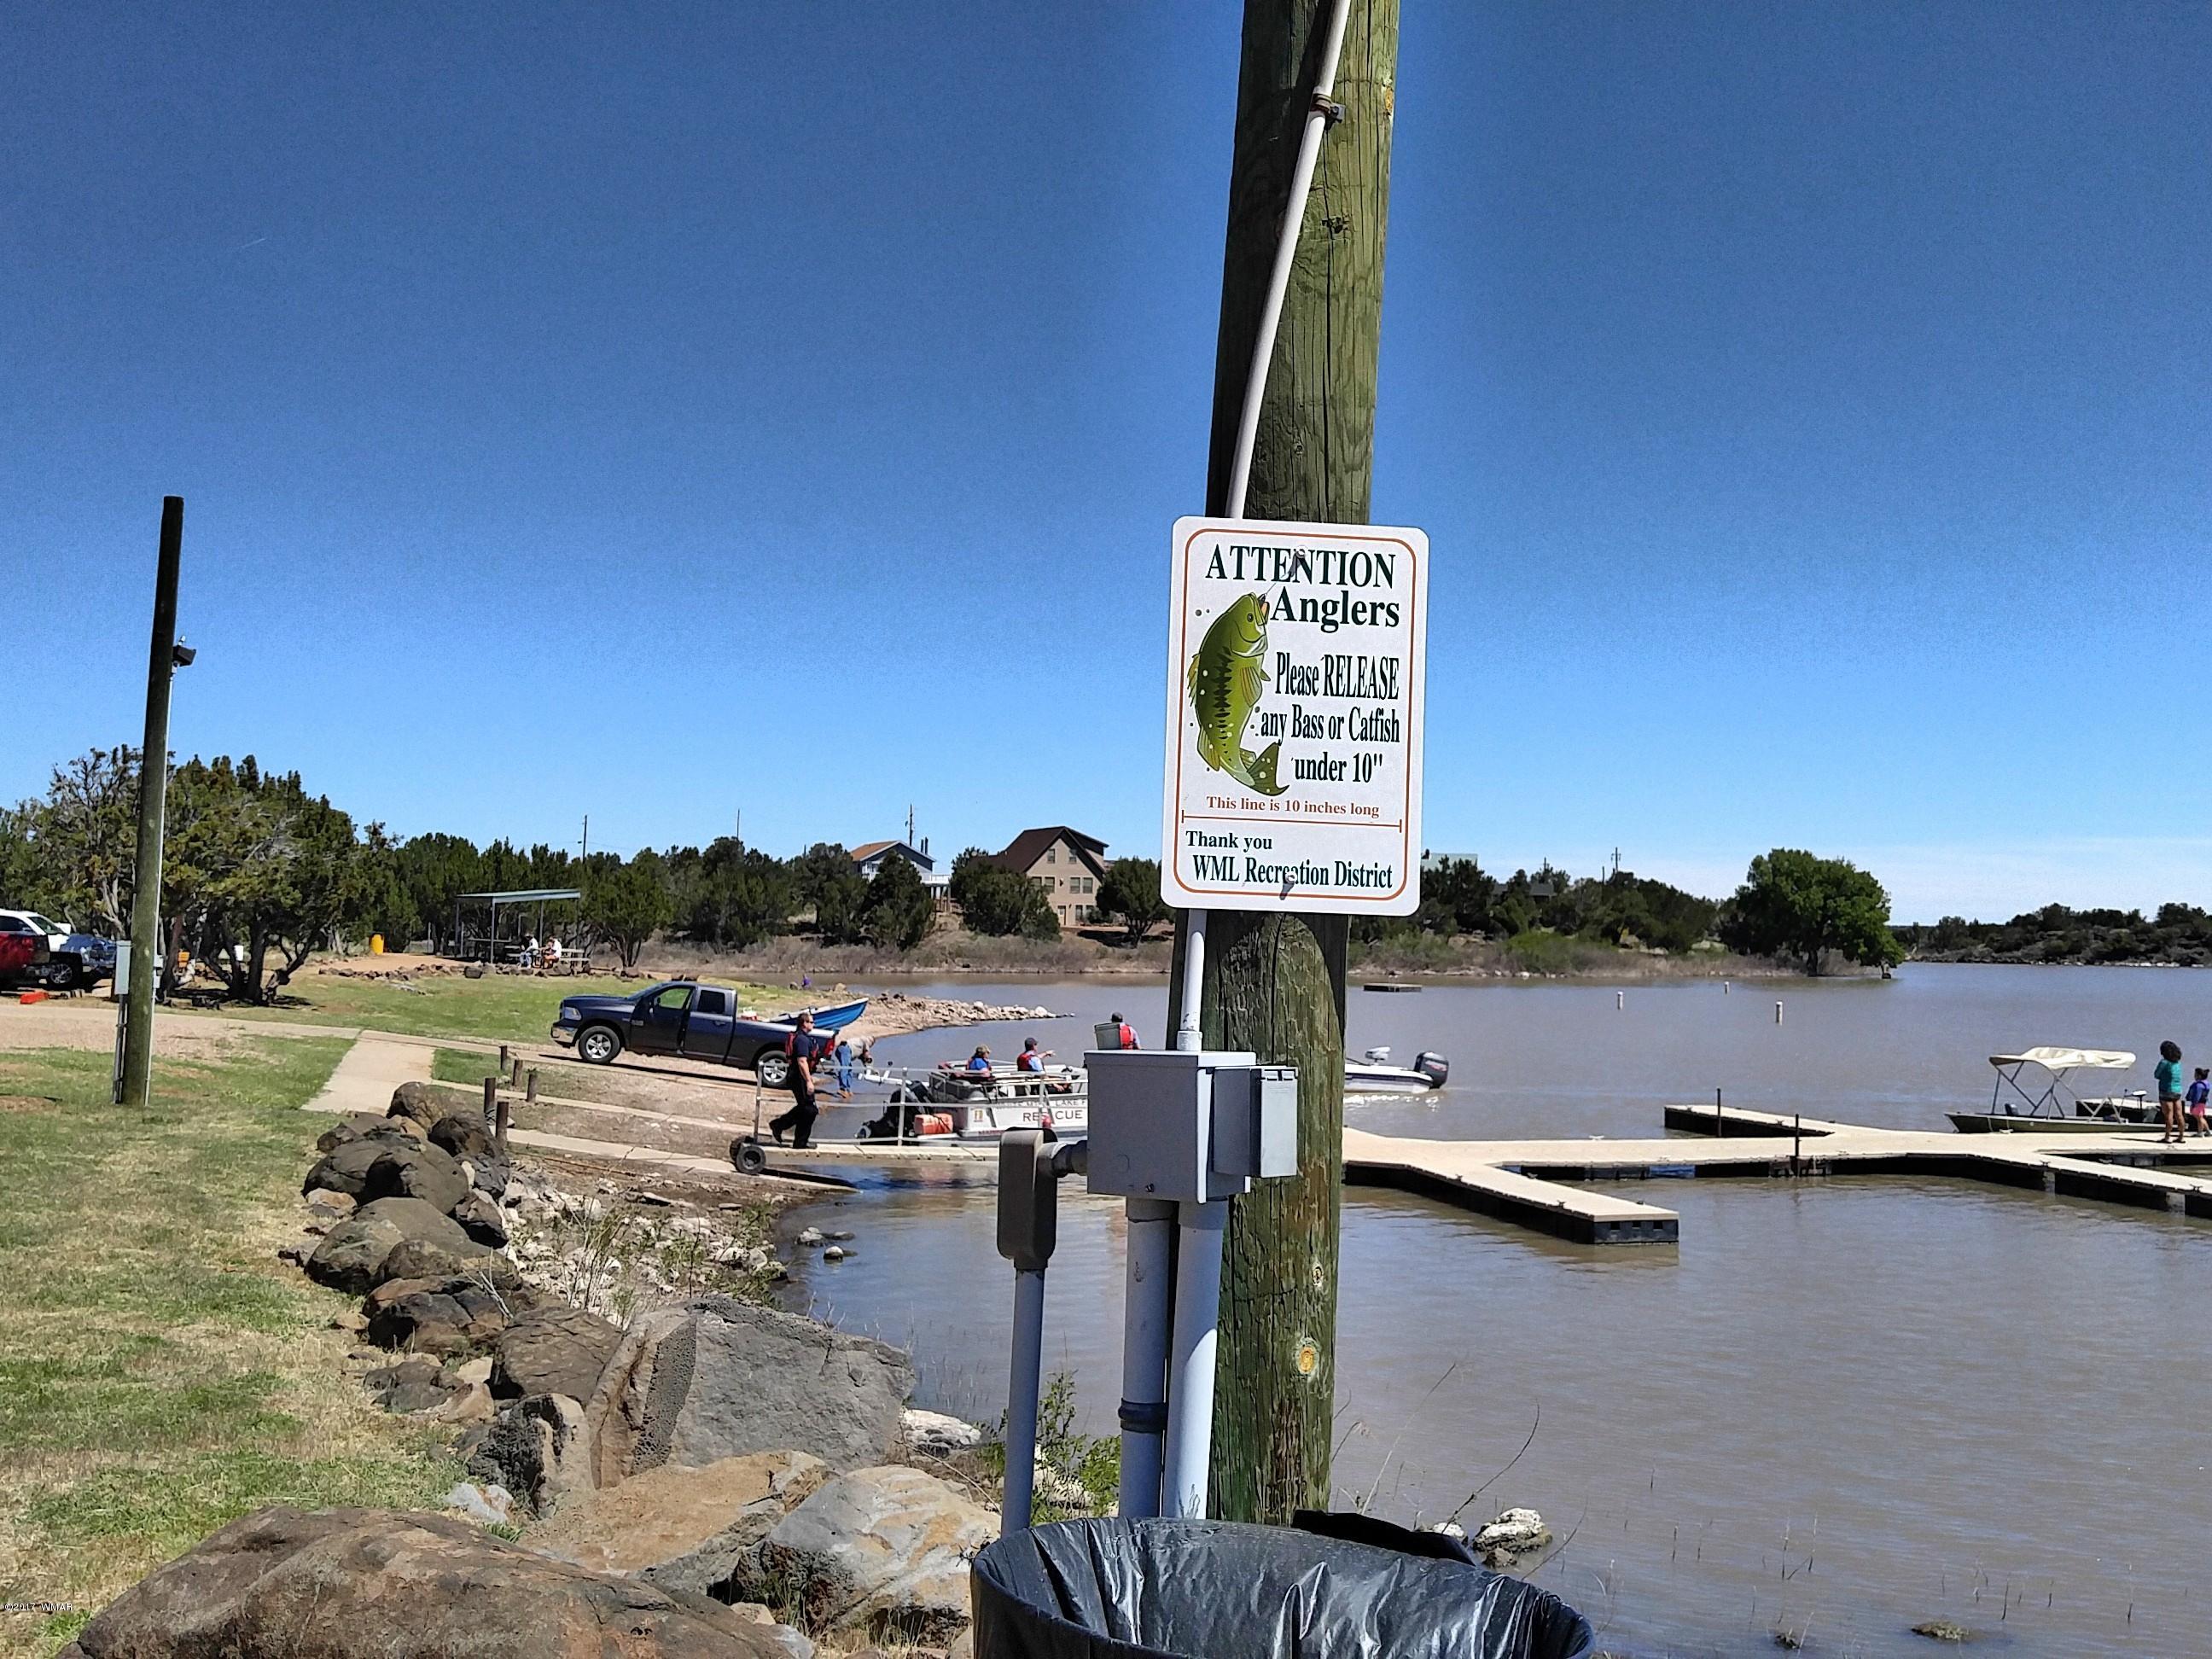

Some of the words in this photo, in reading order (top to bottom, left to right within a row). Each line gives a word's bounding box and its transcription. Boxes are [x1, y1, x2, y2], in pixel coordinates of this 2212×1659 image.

[1205, 544, 1396, 589] ATTENTION
[1270, 586, 1400, 633] Anglers
[1275, 651, 1319, 696] Please
[1323, 654, 1400, 700] RELEASE
[1260, 710, 1287, 747] any
[1291, 704, 1324, 740] Bass
[1328, 717, 1345, 740] or
[1348, 706, 1400, 742] Catfish
[1295, 752, 1348, 782] under
[1353, 753, 1383, 783] 10"
[1207, 795, 1237, 811] This
[1241, 798, 1266, 812] line
[1269, 799, 1280, 812] is
[1285, 800, 1301, 812] 10
[1304, 800, 1347, 815] inches
[1350, 802, 1380, 819] long
[1185, 830, 1239, 849] Thank
[1243, 837, 1273, 853] you
[1192, 854, 1240, 882] WML
[1244, 856, 1330, 886] Recreation
[1334, 860, 1393, 889] District
